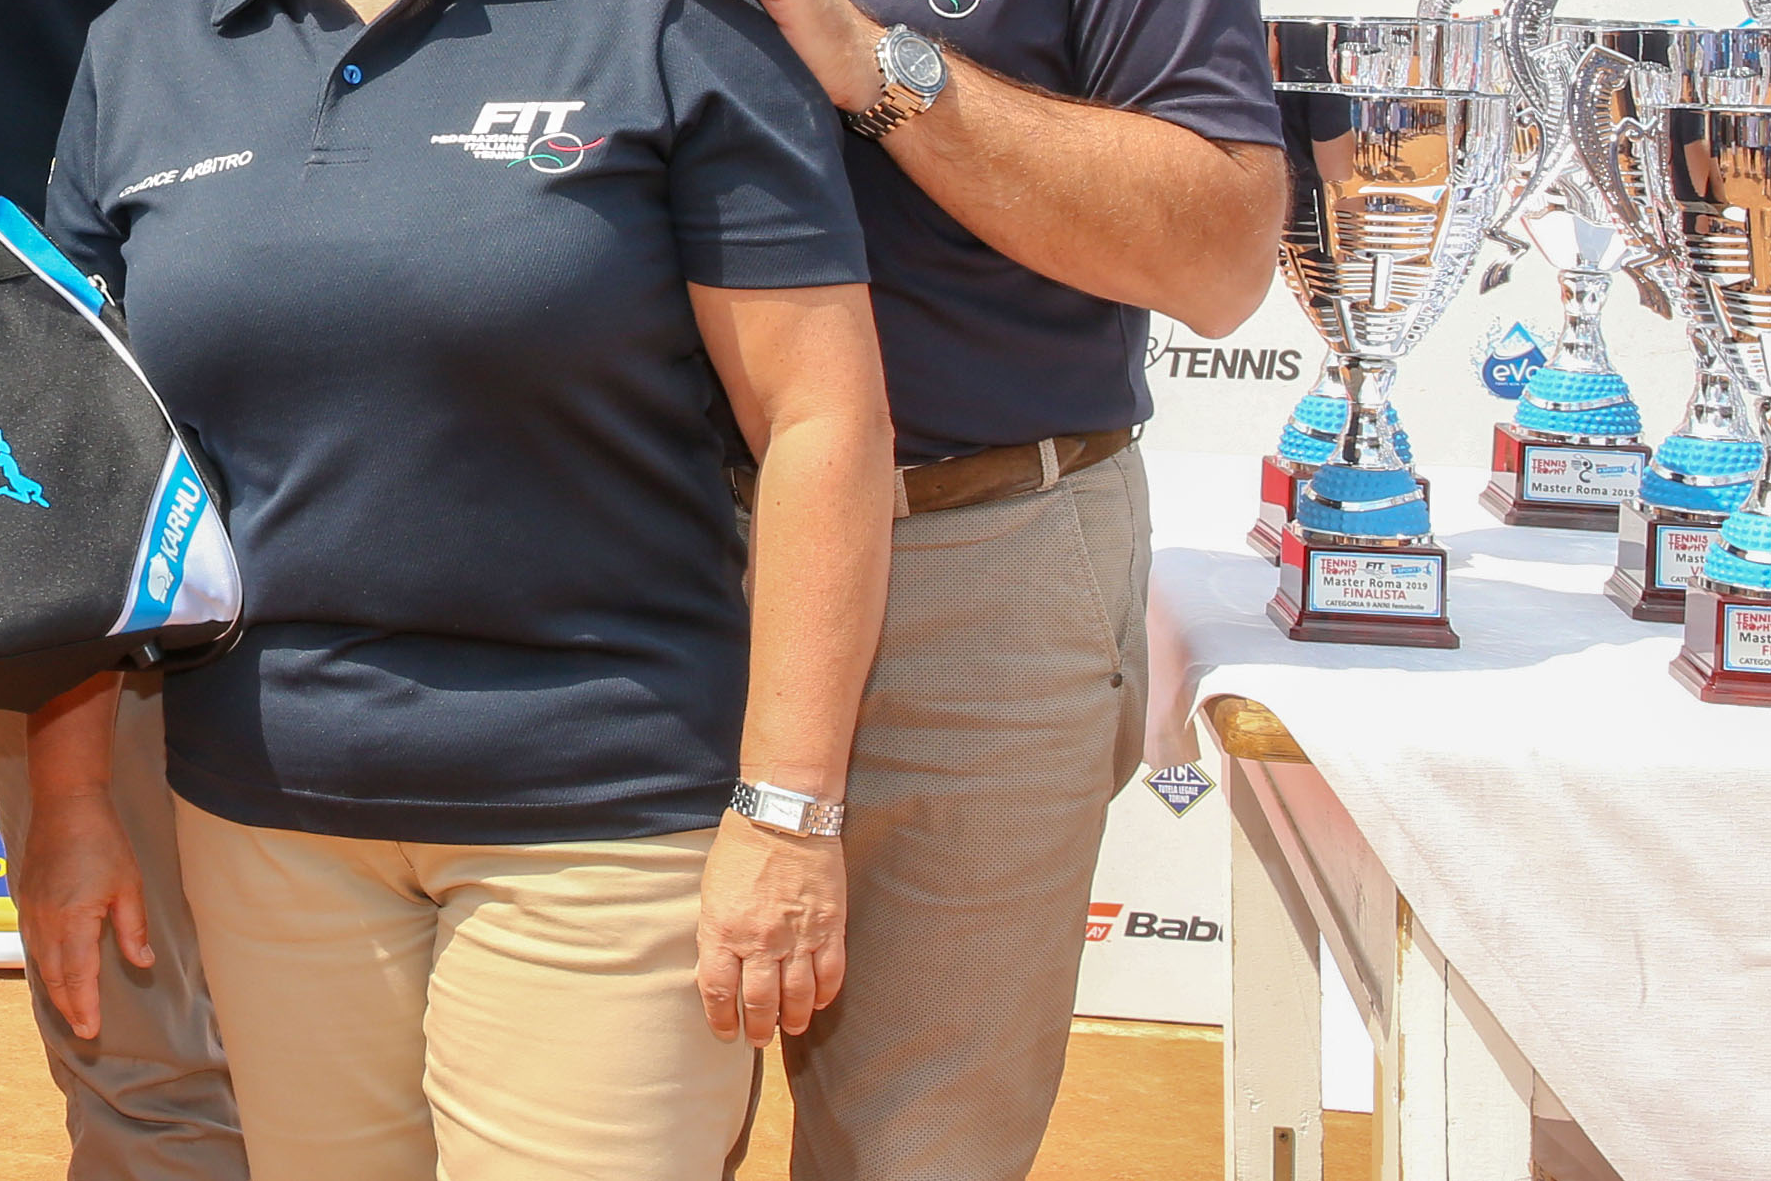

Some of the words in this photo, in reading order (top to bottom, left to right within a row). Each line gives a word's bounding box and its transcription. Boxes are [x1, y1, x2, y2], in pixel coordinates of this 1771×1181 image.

[471, 101, 586, 135] FIT
[180, 150, 253, 182] ARBITRO
[1166, 347, 1303, 381] TENNIS
[1531, 459, 1567, 468] TENNIS
[1532, 483, 1572, 493] Master
[1576, 485, 1608, 495] Roma
[1612, 489, 1634, 497] 2019
[160, 476, 201, 563] KARHU
[1668, 534, 1708, 544] TENNIS
[1321, 559, 1357, 568] TENNIS
[1366, 562, 1385, 570] FIT
[1323, 577, 1364, 587] Master
[1369, 578, 1401, 589] Roma
[1406, 582, 1428, 590] 2019
[1343, 588, 1406, 600] FINALISTA
[1325, 600, 1364, 608] CATEGORIA
